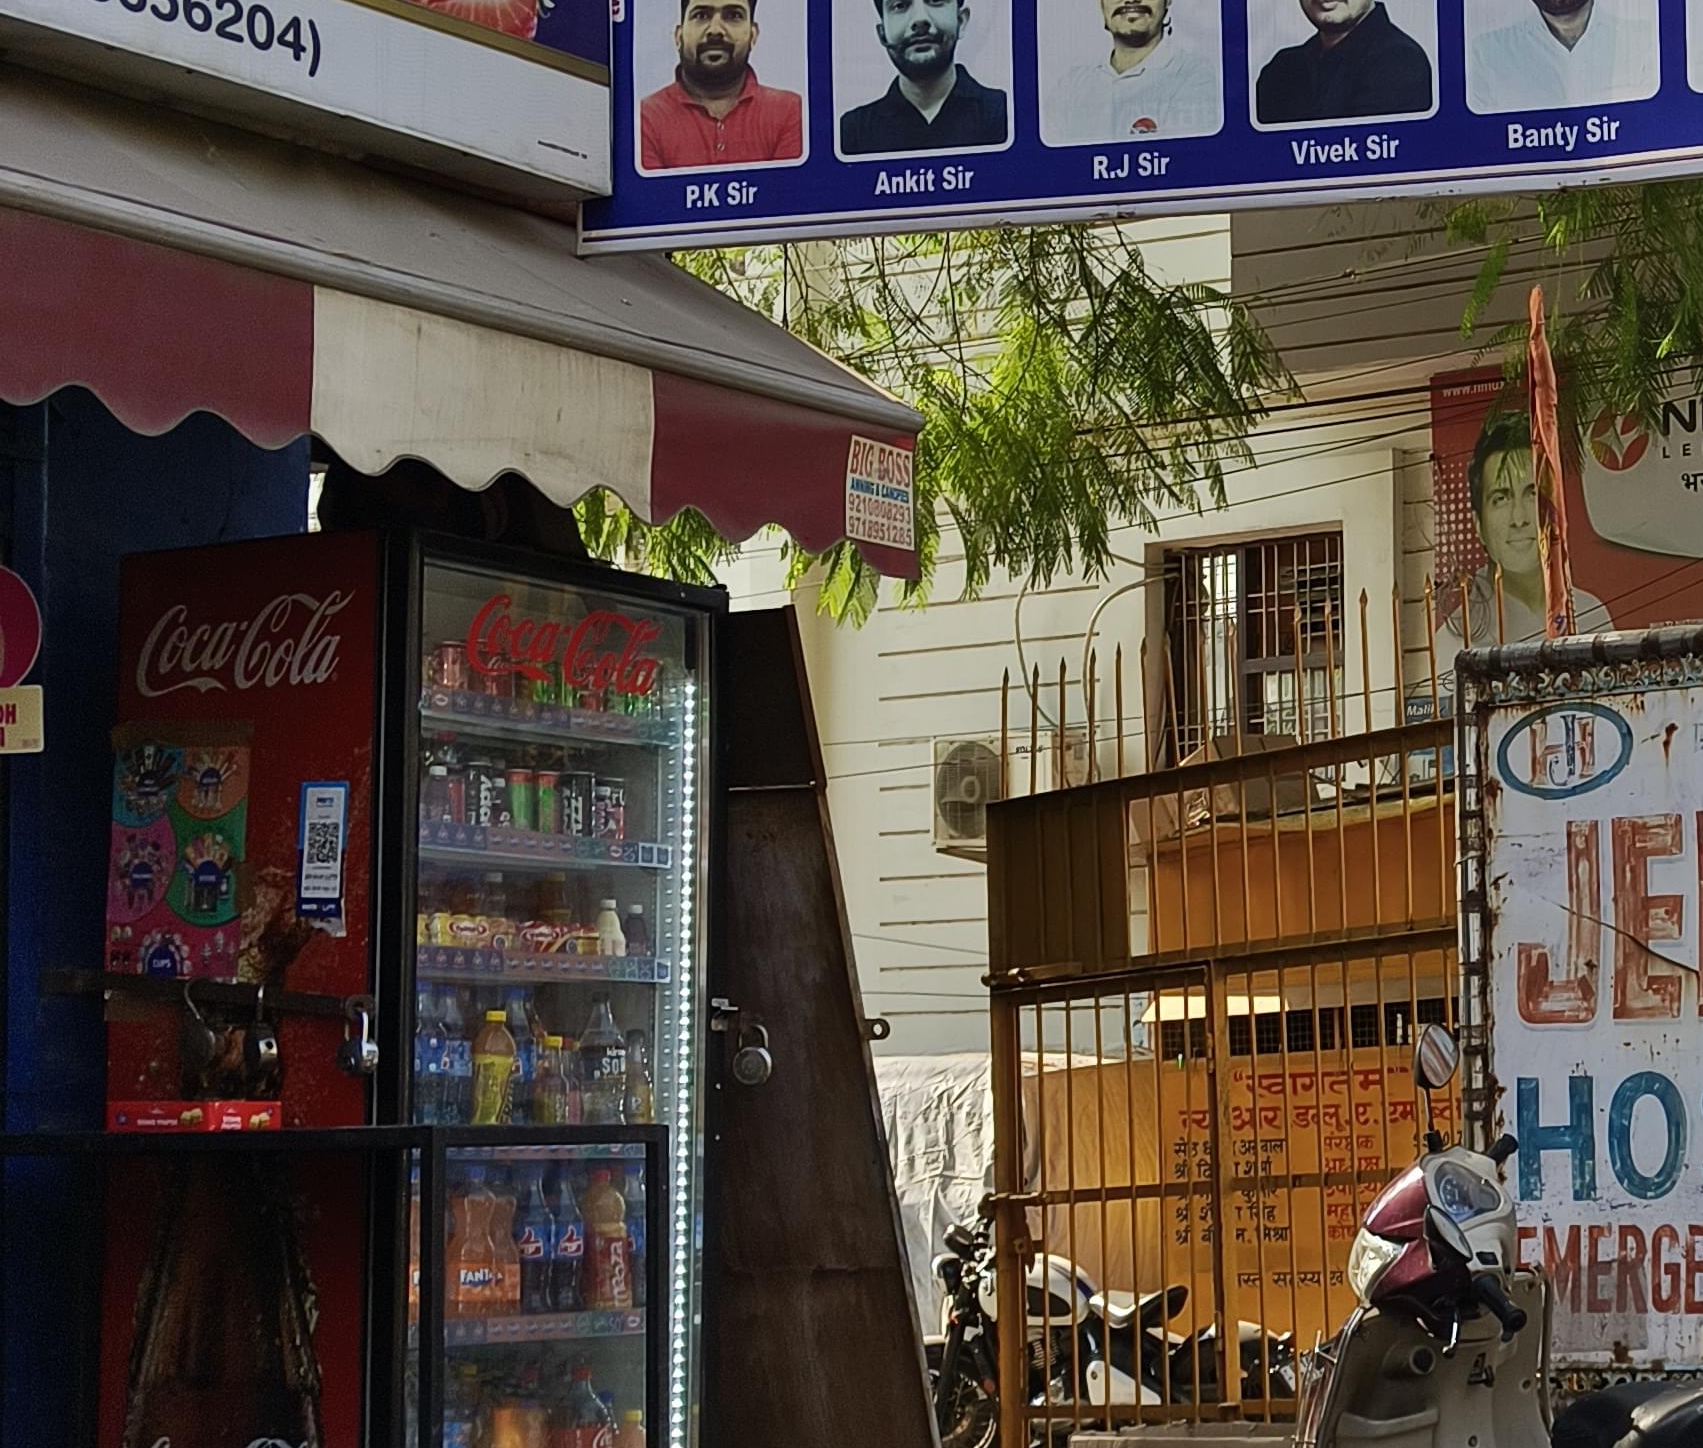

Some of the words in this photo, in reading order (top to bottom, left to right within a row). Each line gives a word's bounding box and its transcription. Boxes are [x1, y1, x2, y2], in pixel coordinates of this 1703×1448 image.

[1507, 119, 1580, 150] Banty
[1586, 116, 1620, 143] Sir
[1291, 139, 1358, 166] Vivek
[1366, 133, 1400, 160] Sir
[875, 170, 937, 196] Ankit
[941, 166, 974, 191] Sir
[1092, 156, 1130, 180] R.J
[1136, 153, 1170, 178] Sir
[685, 184, 720, 209] P.K
[726, 182, 758, 206] Sir
[850, 439, 874, 478] BIG
[878, 447, 911, 488] BOSS
